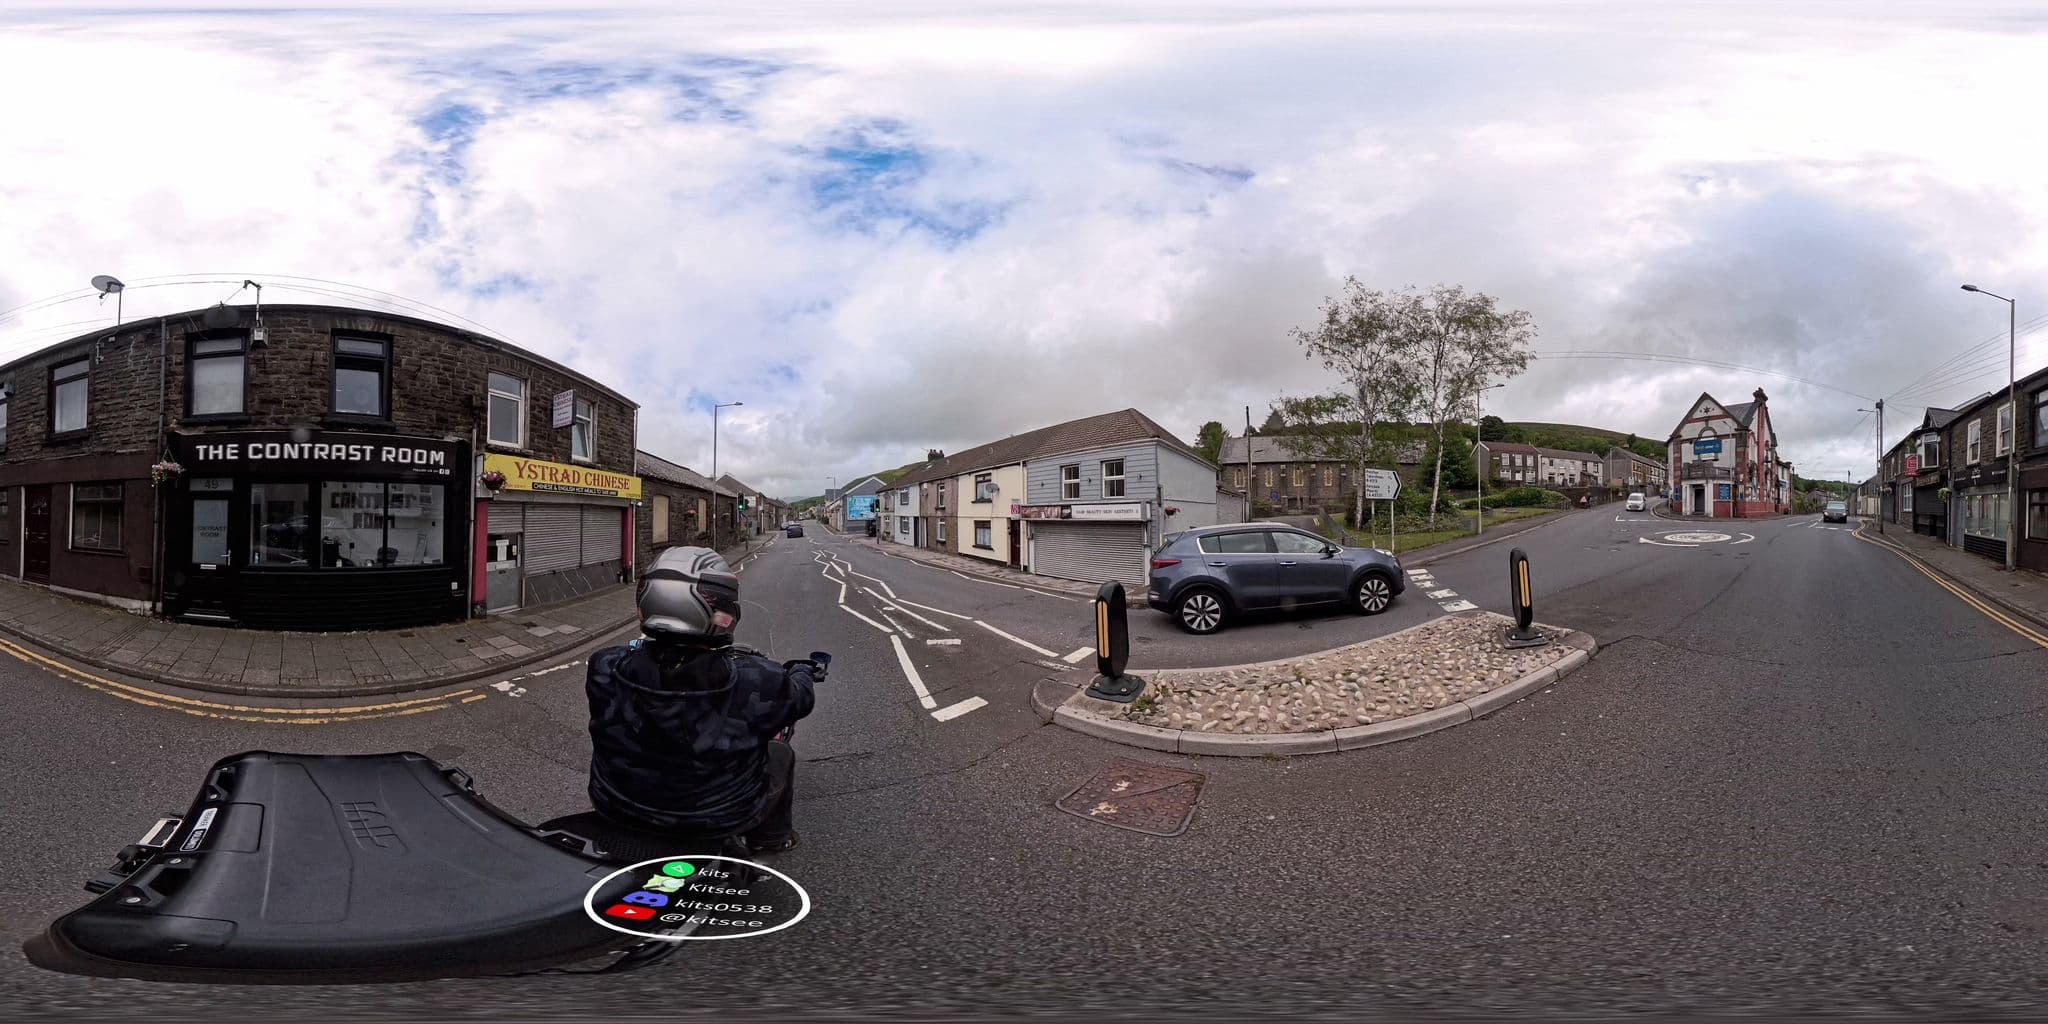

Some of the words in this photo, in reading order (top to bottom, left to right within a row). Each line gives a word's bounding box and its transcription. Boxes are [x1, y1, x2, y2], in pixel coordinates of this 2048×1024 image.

[196, 444, 239, 460] THE
[248, 443, 374, 461] CONTRAST
[382, 446, 445, 466] ROOM
[514, 460, 581, 484] YSTRAD
[584, 471, 630, 490] CHINESE
